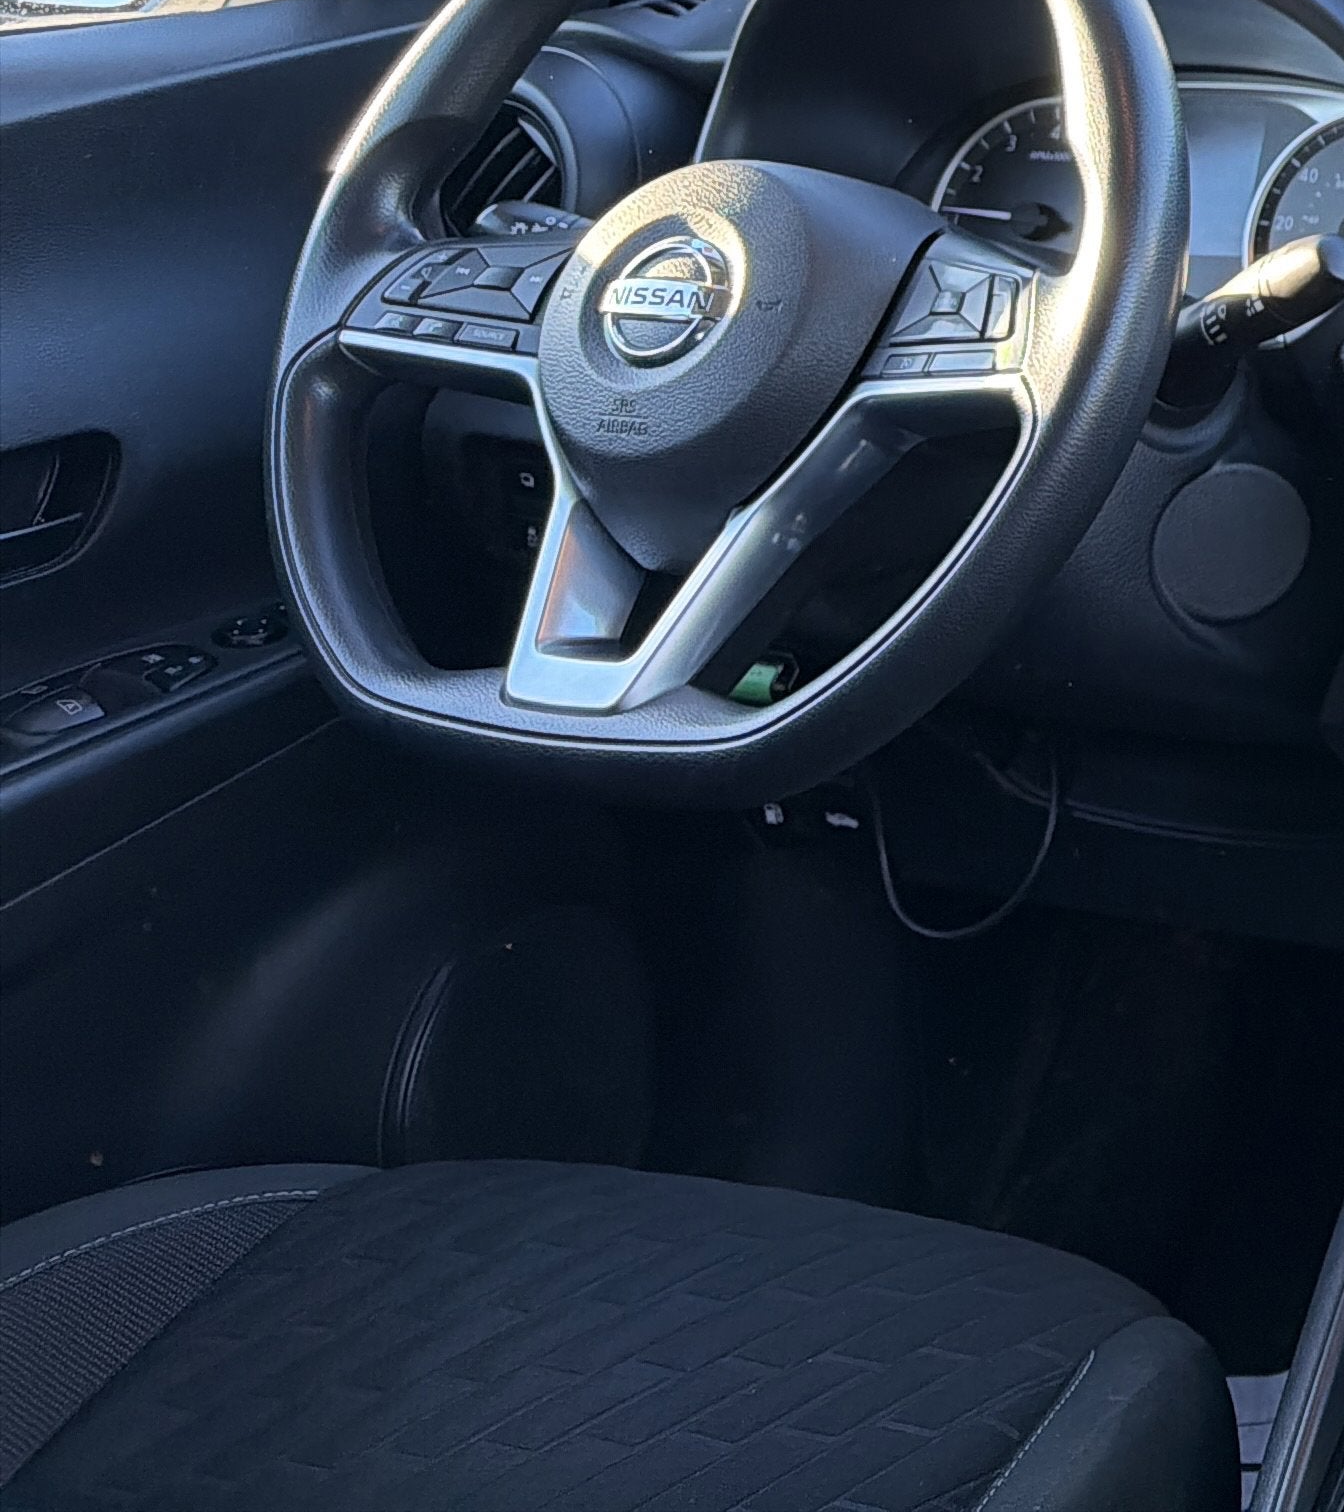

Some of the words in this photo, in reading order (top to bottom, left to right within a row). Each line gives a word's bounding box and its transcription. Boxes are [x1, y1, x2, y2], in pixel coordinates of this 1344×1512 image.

[1005, 134, 1018, 152] 3
[971, 165, 984, 183] 2
[1298, 167, 1319, 183] 40
[1275, 216, 1294, 231] 20
[609, 286, 716, 313] NISSAN
